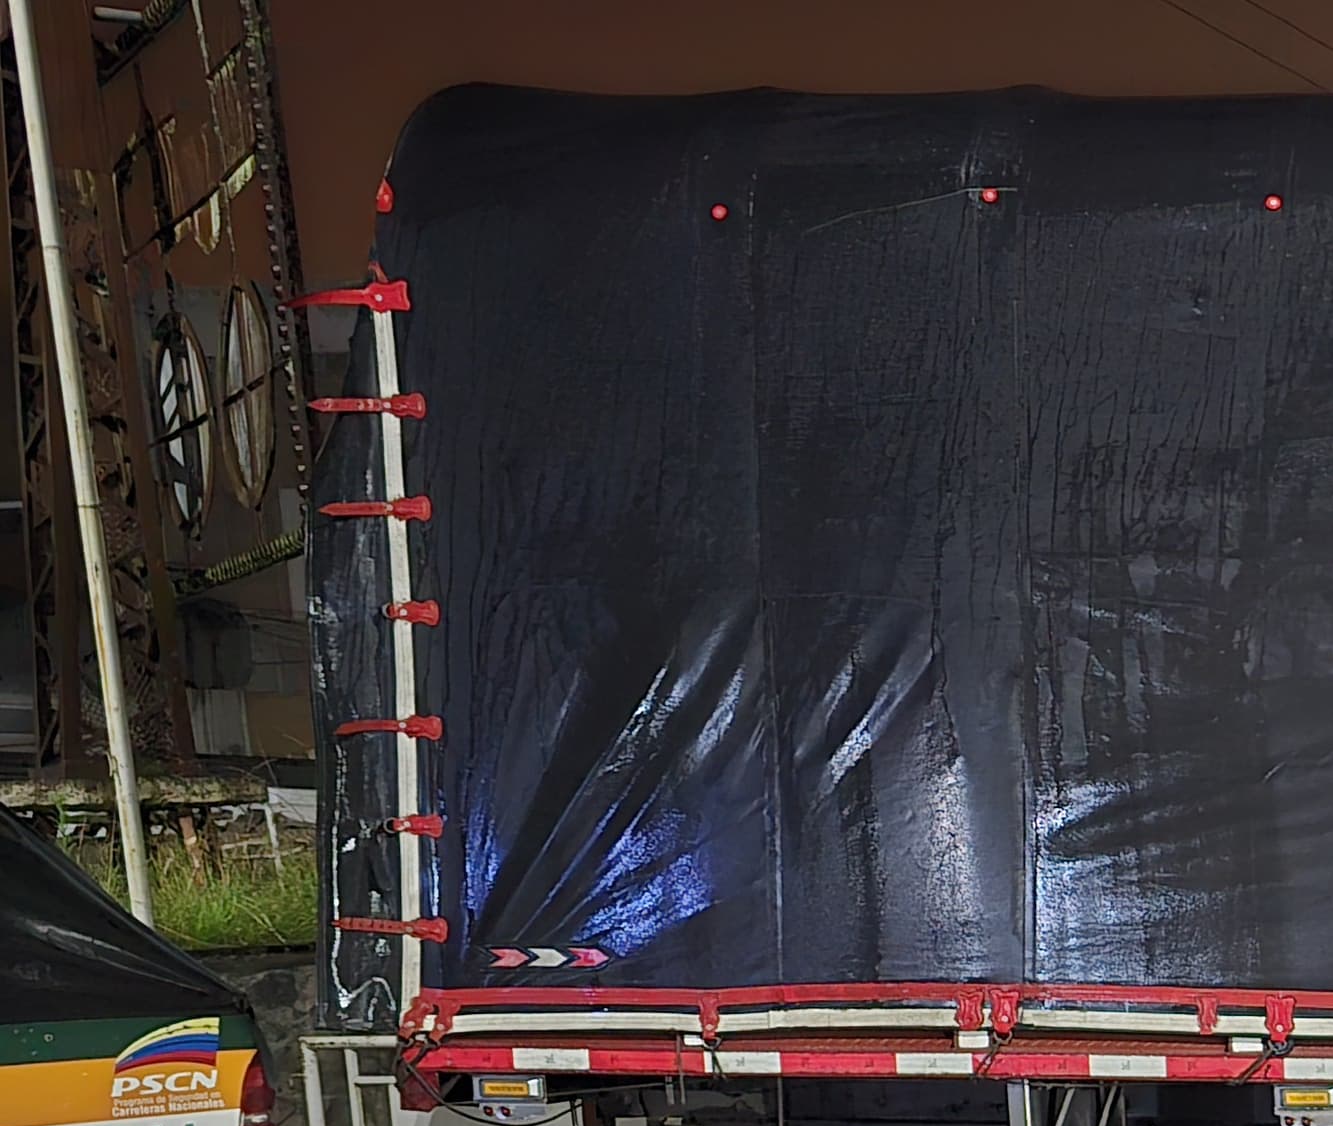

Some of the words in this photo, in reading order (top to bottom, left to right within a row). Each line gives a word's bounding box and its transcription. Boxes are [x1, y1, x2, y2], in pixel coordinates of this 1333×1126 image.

[111, 1069, 218, 1098] PSCN
[111, 1103, 166, 1118] Carreteras
[168, 1098, 225, 1113] Nacionales
